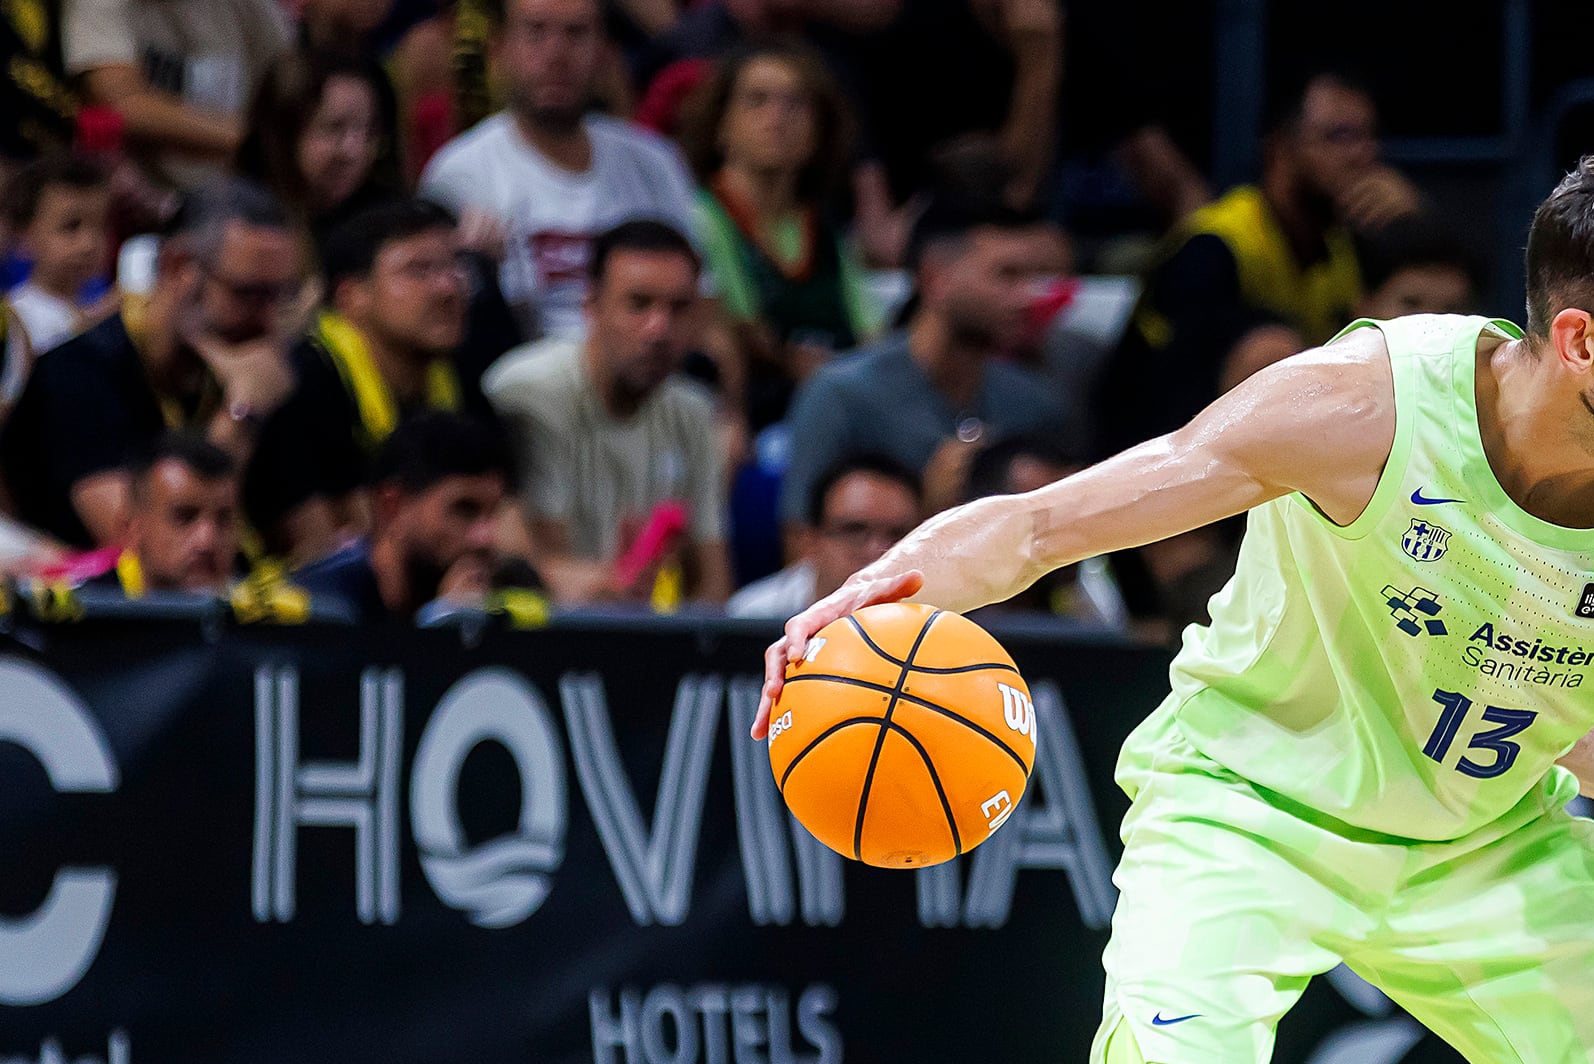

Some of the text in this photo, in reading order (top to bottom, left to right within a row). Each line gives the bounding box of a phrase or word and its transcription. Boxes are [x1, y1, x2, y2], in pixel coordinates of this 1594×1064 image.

[1461, 646, 1584, 688] Sanitària
[1422, 688, 1539, 779] 13
[252, 664, 1114, 930] HOVIA
